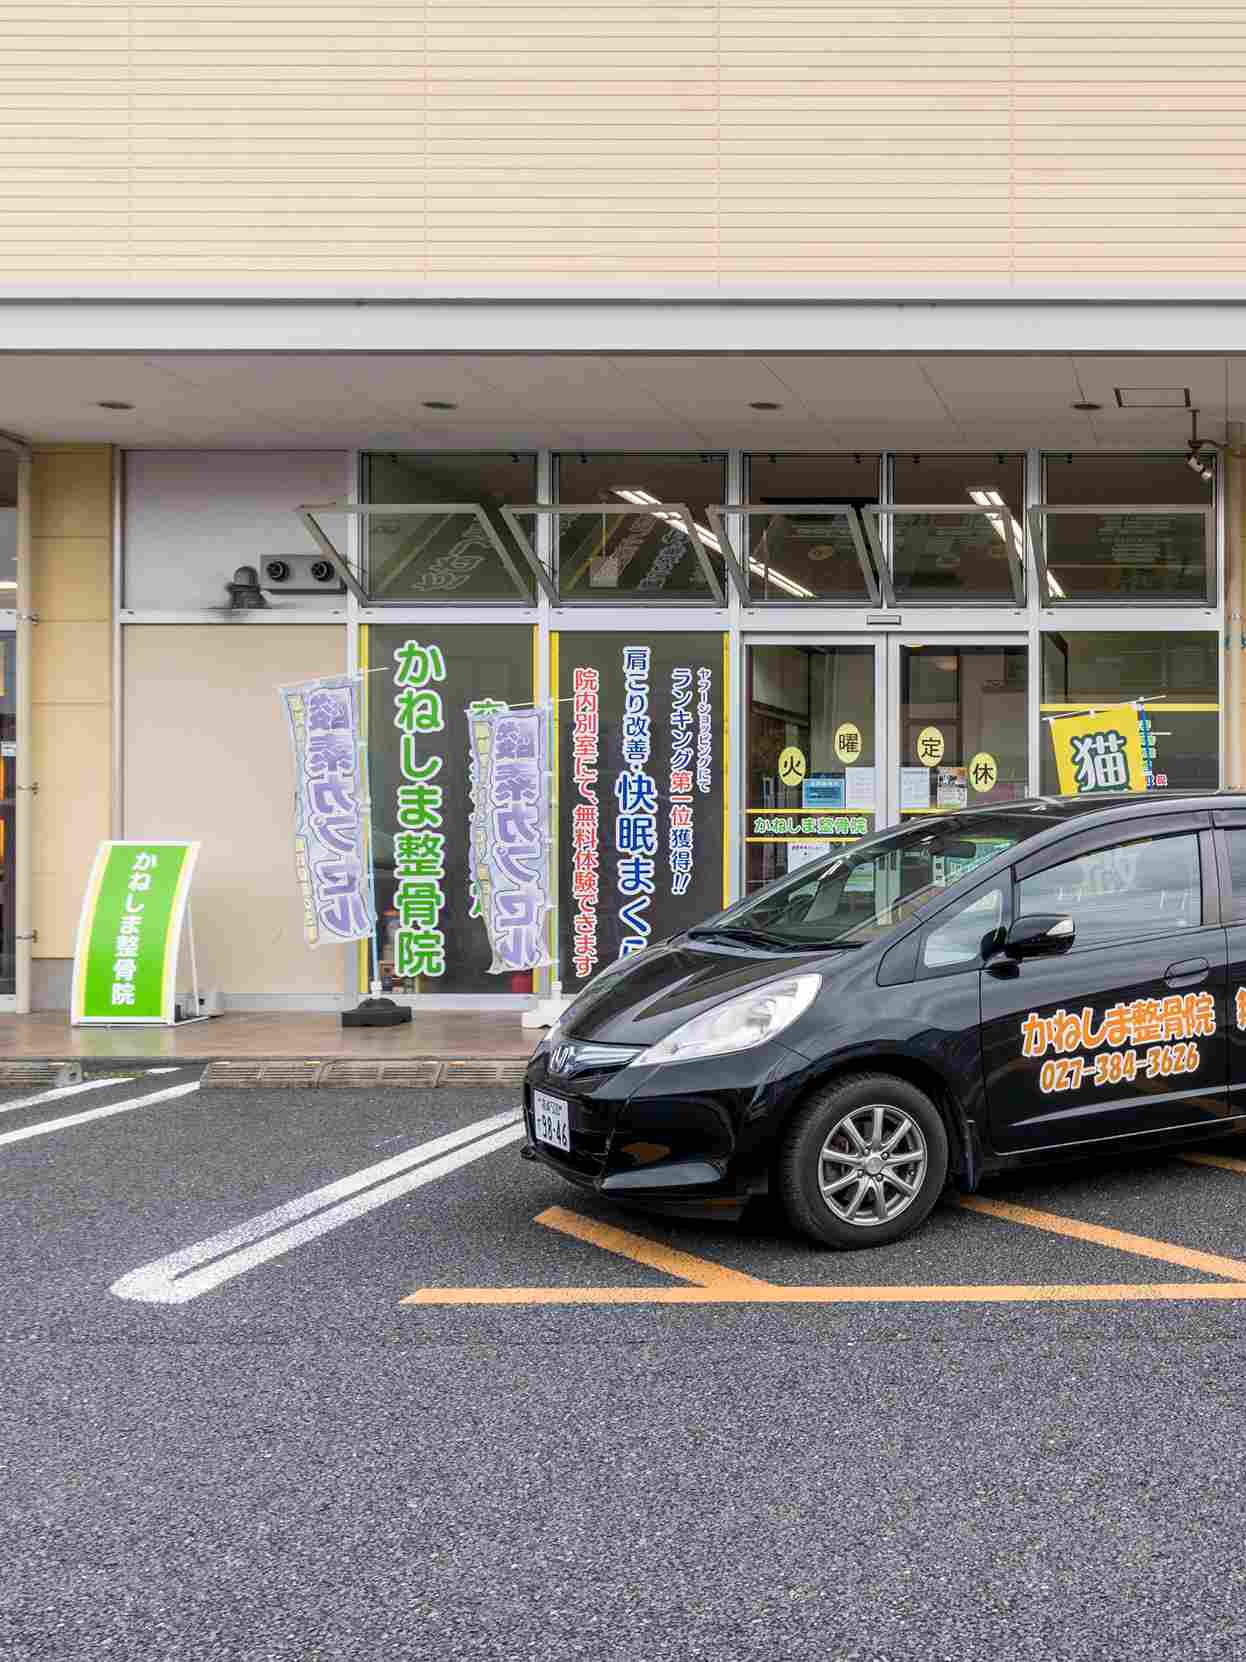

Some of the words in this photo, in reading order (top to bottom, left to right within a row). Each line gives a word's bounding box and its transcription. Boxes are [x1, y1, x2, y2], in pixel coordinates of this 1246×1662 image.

[1070, 731, 1130, 794] 猫
[393, 640, 445, 978] かねしま整骨院
[753, 816, 868, 834] かねしま整骨院
[111, 851, 160, 1006] かねしま整骨院
[1021, 991, 1217, 1057] かねしま整骨院
[1040, 1042, 1200, 1093] 027-384-3626
